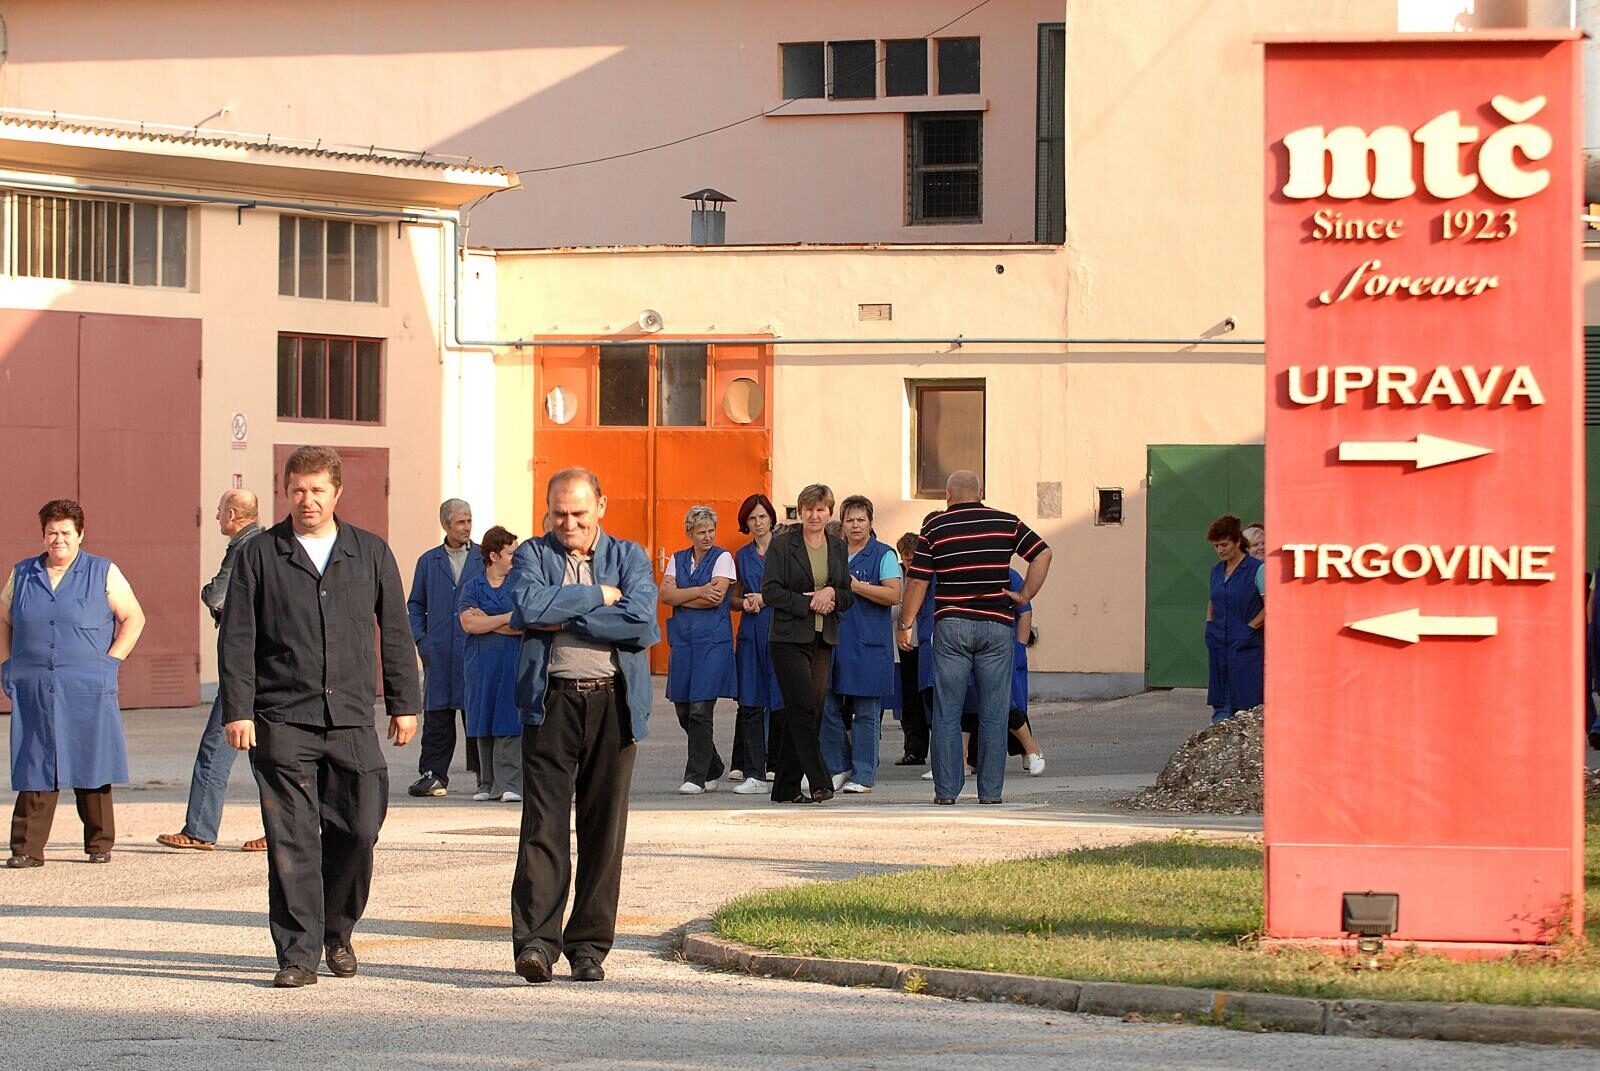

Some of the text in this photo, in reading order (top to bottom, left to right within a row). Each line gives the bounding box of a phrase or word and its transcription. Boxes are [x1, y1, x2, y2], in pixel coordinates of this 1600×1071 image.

[1282, 95, 1552, 199] mtč
[1312, 208, 1518, 240] Since 1923
[1319, 259, 1499, 304] forever
[1288, 365, 1546, 405] UPRAVA
[1281, 543, 1556, 581] TRGOVINE
